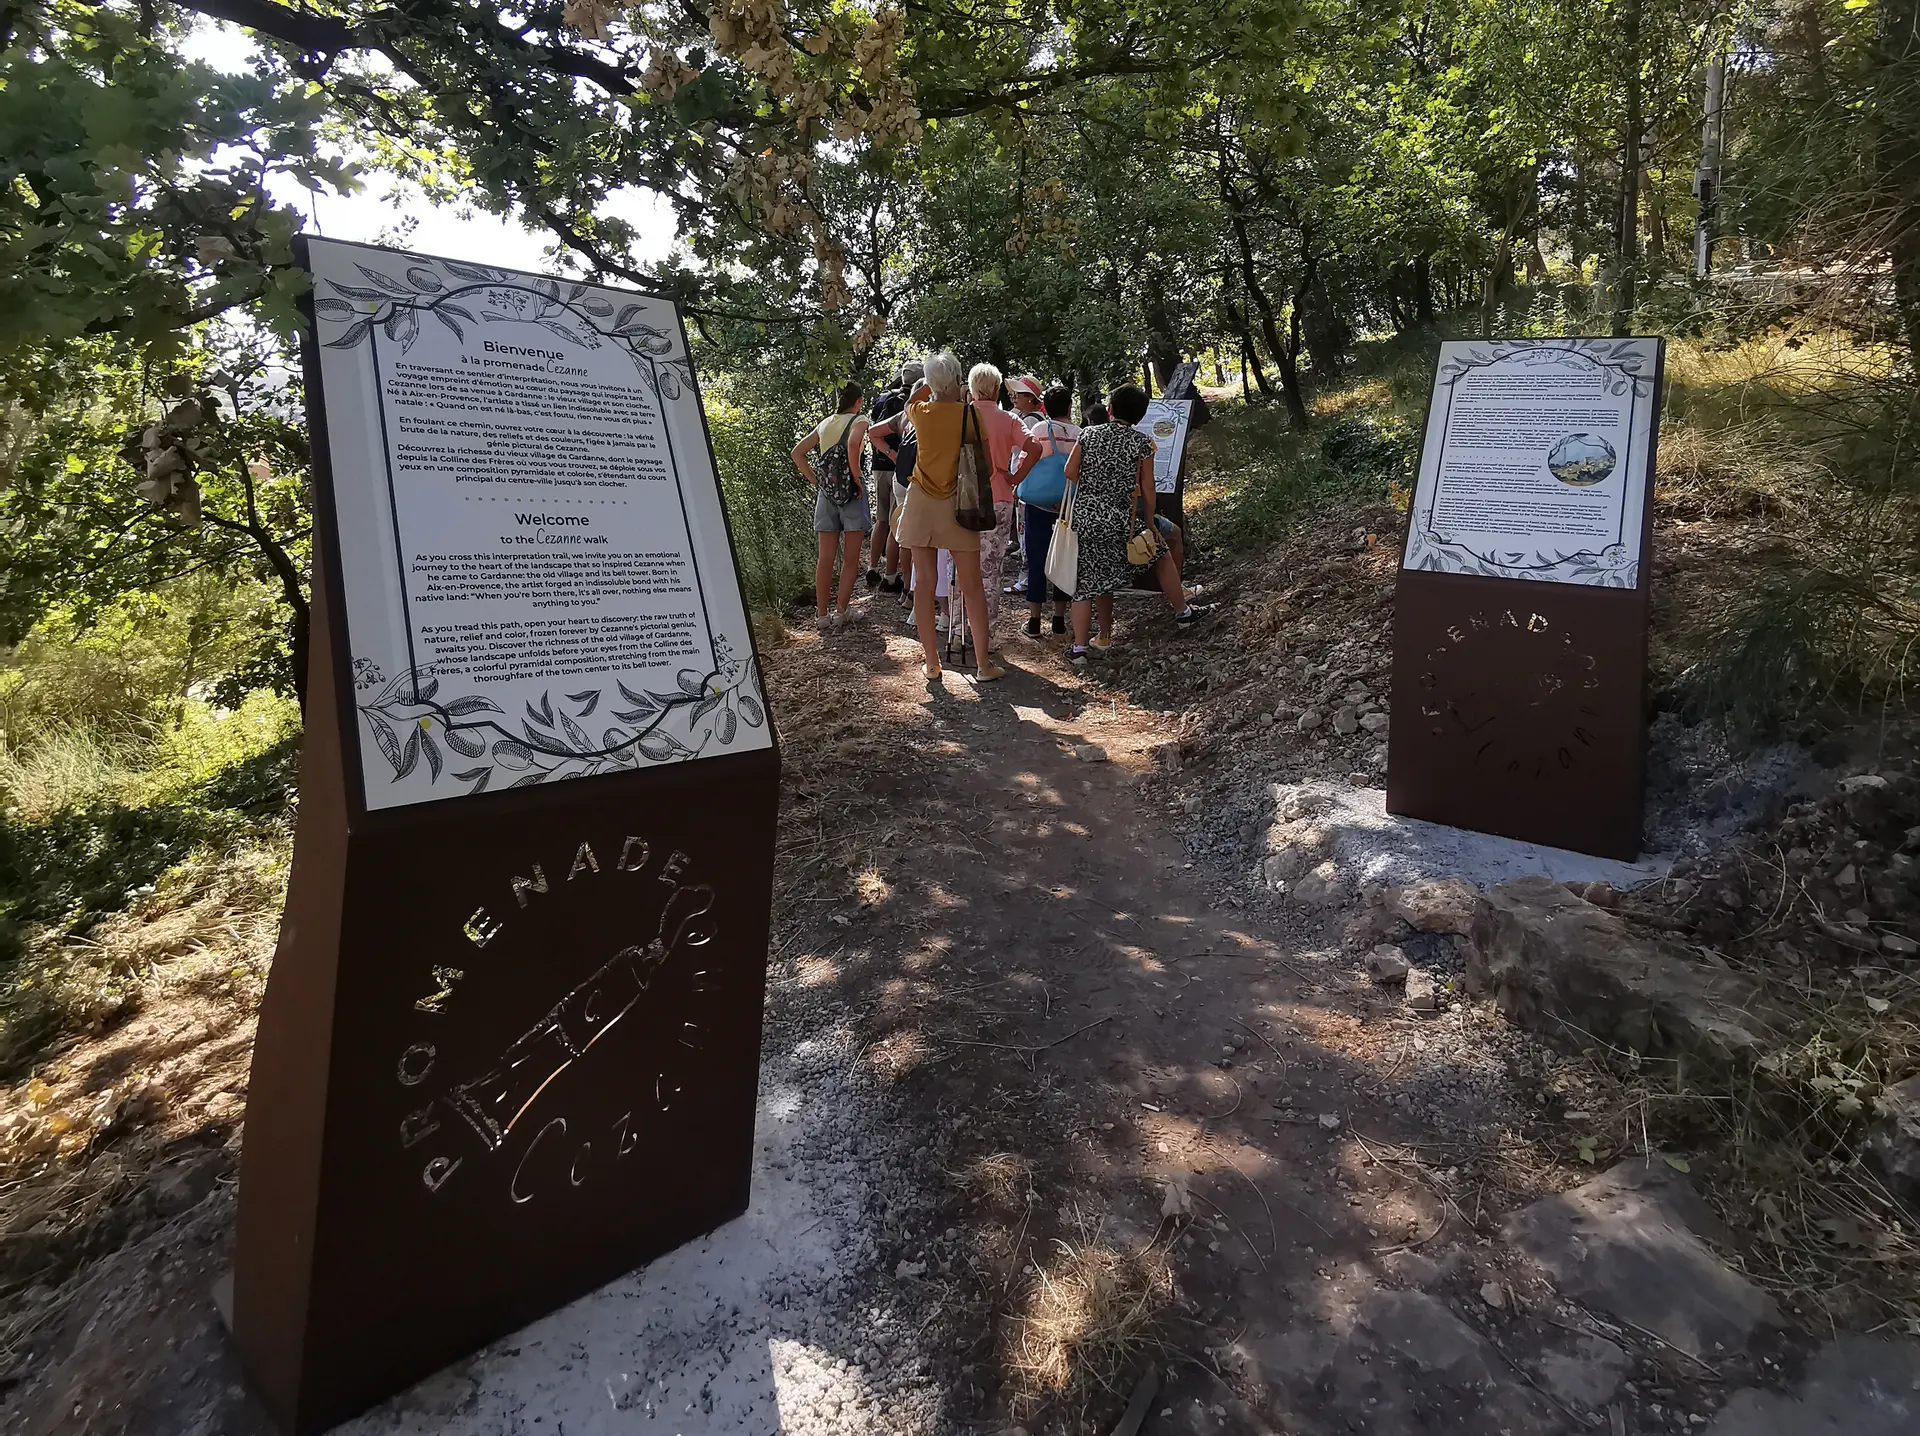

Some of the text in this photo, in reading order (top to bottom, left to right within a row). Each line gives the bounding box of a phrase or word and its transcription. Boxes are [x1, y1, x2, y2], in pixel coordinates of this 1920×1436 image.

[484, 340, 564, 360] Bienvenue
[461, 352, 588, 377] à la promenade Cezanne
[395, 361, 408, 370] En
[408, 363, 454, 375] traversant
[466, 370, 496, 379] sentier
[560, 380, 579, 388] nous
[579, 382, 598, 390] vous
[598, 383, 626, 393] invitons
[627, 385, 632, 393] à
[395, 372, 429, 382] voyage
[430, 375, 471, 385] empreint
[525, 385, 547, 393] cœur
[547, 385, 559, 394] du
[559, 388, 591, 398] paysage
[591, 390, 604, 399] qui
[604, 391, 629, 401] inspira
[628, 394, 644, 402] tant
[386, 388, 400, 396] Né
[401, 389, 408, 397] à
[409, 390, 483, 404] Aix-en-Provence,
[483, 396, 514, 406] l'artiste
[521, 399, 540, 408] tissé
[552, 402, 568, 410] lien
[568, 403, 612, 414] indissoluble
[613, 408, 630, 416] avec
[638, 410, 656, 418] terre
[397, 443, 663, 466] Découvrez la richesse du vieux village de Gardanne, dont le paysage
[486, 439, 590, 453] génie pictural de Cezanne.
[398, 464, 422, 472] yeux
[456, 466, 510, 475] composition
[510, 468, 556, 476] pyramidale
[636, 472, 647, 480] du
[455, 475, 494, 485] principal
[494, 476, 507, 484] du
[507, 477, 553, 485] centre-ville
[598, 479, 628, 487] clocher.
[514, 513, 590, 526] Welcome
[499, 528, 609, 544] to the Cezanne walk
[412, 563, 449, 573] journey
[503, 562, 513, 570] of
[514, 562, 530, 570] the
[530, 561, 573, 570] landscape
[573, 561, 591, 569] that
[601, 560, 633, 569] inspired
[665, 559, 686, 567] when
[415, 553, 428, 561] As
[428, 555, 447, 563] you
[473, 553, 491, 561] this
[492, 552, 551, 562] interpretation
[551, 552, 571, 560] trail,
[584, 551, 607, 559] invite
[607, 553, 622, 561] you
[644, 550, 681, 558] emotional
[426, 583, 504, 592] Aix-en-Provence,
[504, 581, 520, 589] the
[521, 581, 544, 589] artist
[544, 579, 573, 589] forged
[585, 578, 631, 587] indissoluble
[631, 577, 652, 585] bond
[652, 577, 670, 585] with
[669, 576, 681, 584] his
[427, 573, 440, 581] he
[480, 571, 526, 580] Gardanne:
[526, 571, 541, 579] the
[542, 570, 556, 578] old
[556, 570, 584, 579] village
[585, 569, 601, 577] and
[601, 569, 612, 577] its
[612, 569, 627, 577] bell
[651, 568, 670, 576] Born
[670, 568, 678, 576] in
[424, 621, 697, 644] nature, relief and color, frozen forever by Cezanne's pictorial genius,
[472, 662, 508, 673] colorful
[509, 659, 553, 671] pyramidal
[553, 656, 607, 667] composition,
[607, 653, 648, 663] stretching
[648, 651, 668, 659] from
[667, 649, 681, 658] the
[681, 648, 700, 656] main
[473, 661, 672, 683] thoroughfare of the town center to its bell tower.
[397, 835, 692, 1192] PROMENADE
